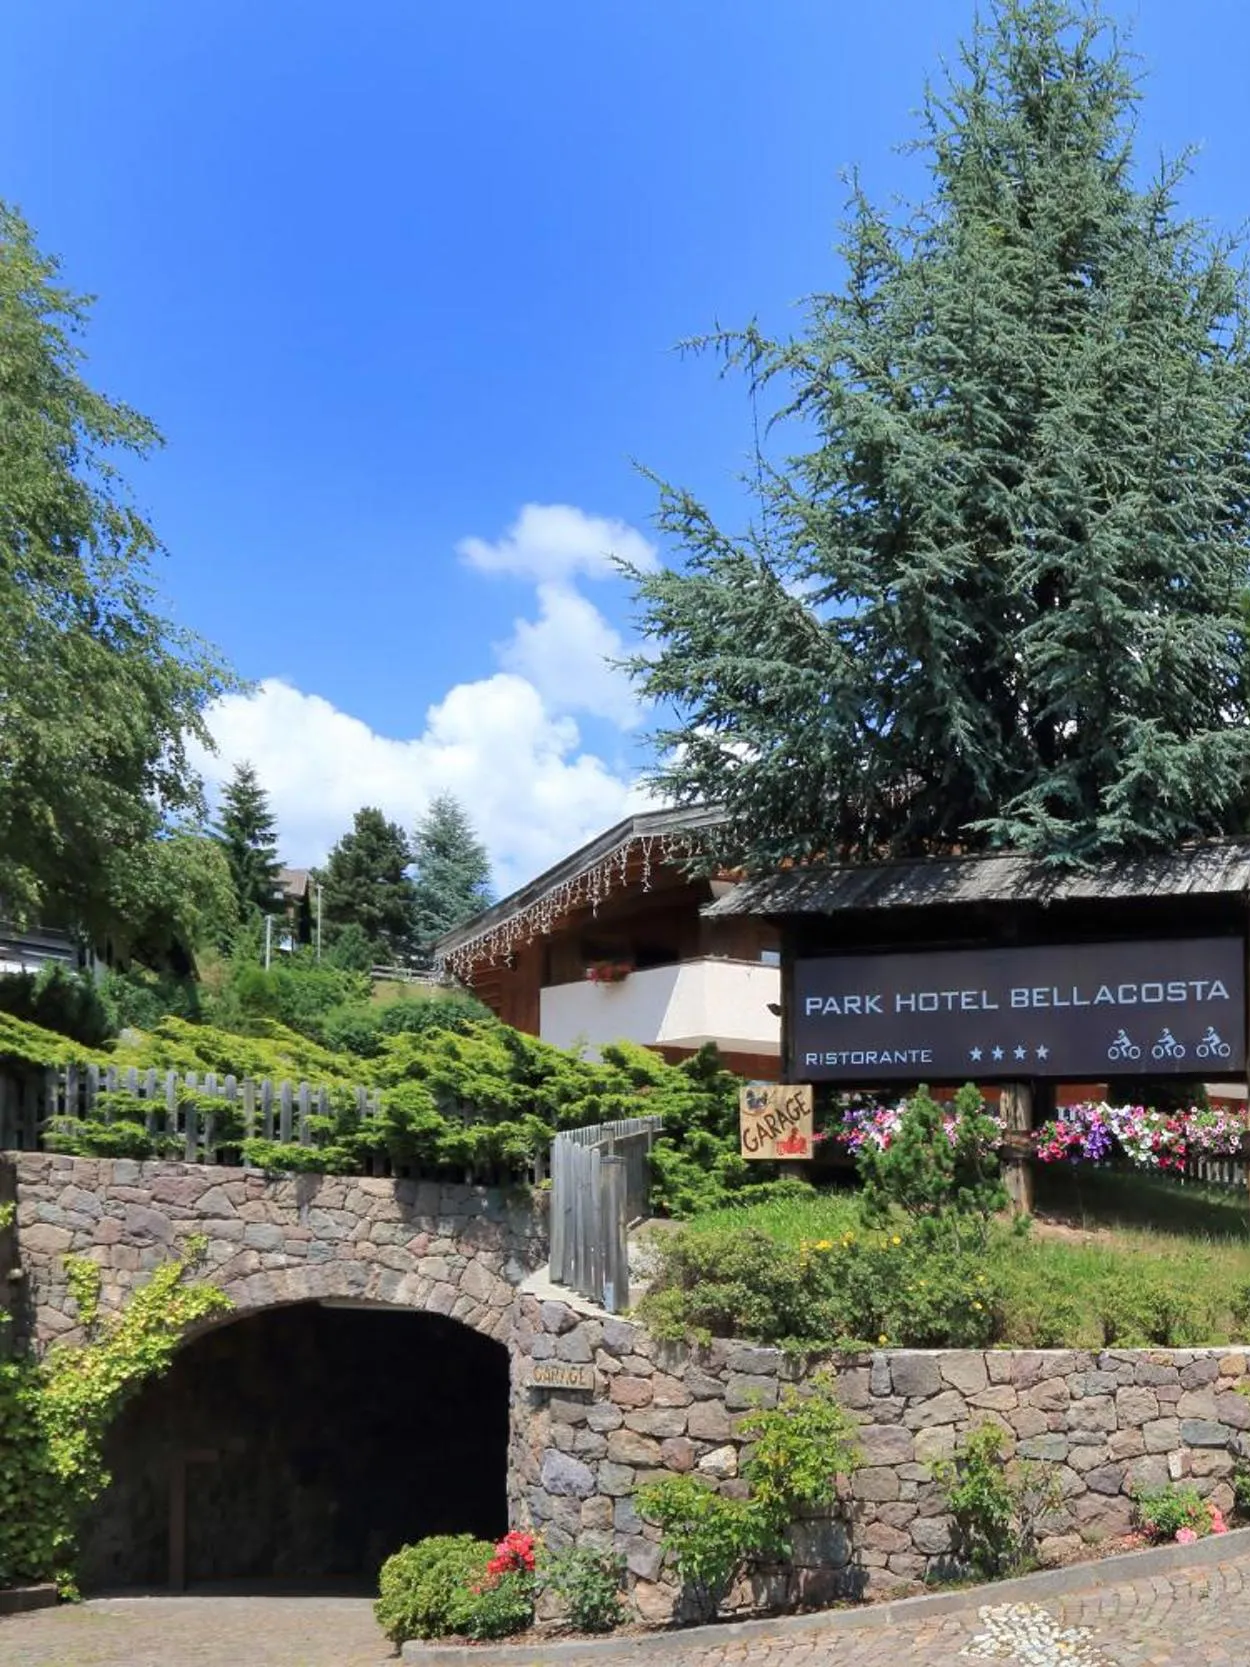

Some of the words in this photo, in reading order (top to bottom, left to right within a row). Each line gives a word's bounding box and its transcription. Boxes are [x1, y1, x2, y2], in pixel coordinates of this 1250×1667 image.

[805, 994, 884, 1016] PARK
[894, 990, 1000, 1013] HOTEL
[1010, 979, 1231, 1009] BELLACOSTA
[804, 1049, 933, 1066] RISTORANTE
[742, 1090, 811, 1152] GARAGE
